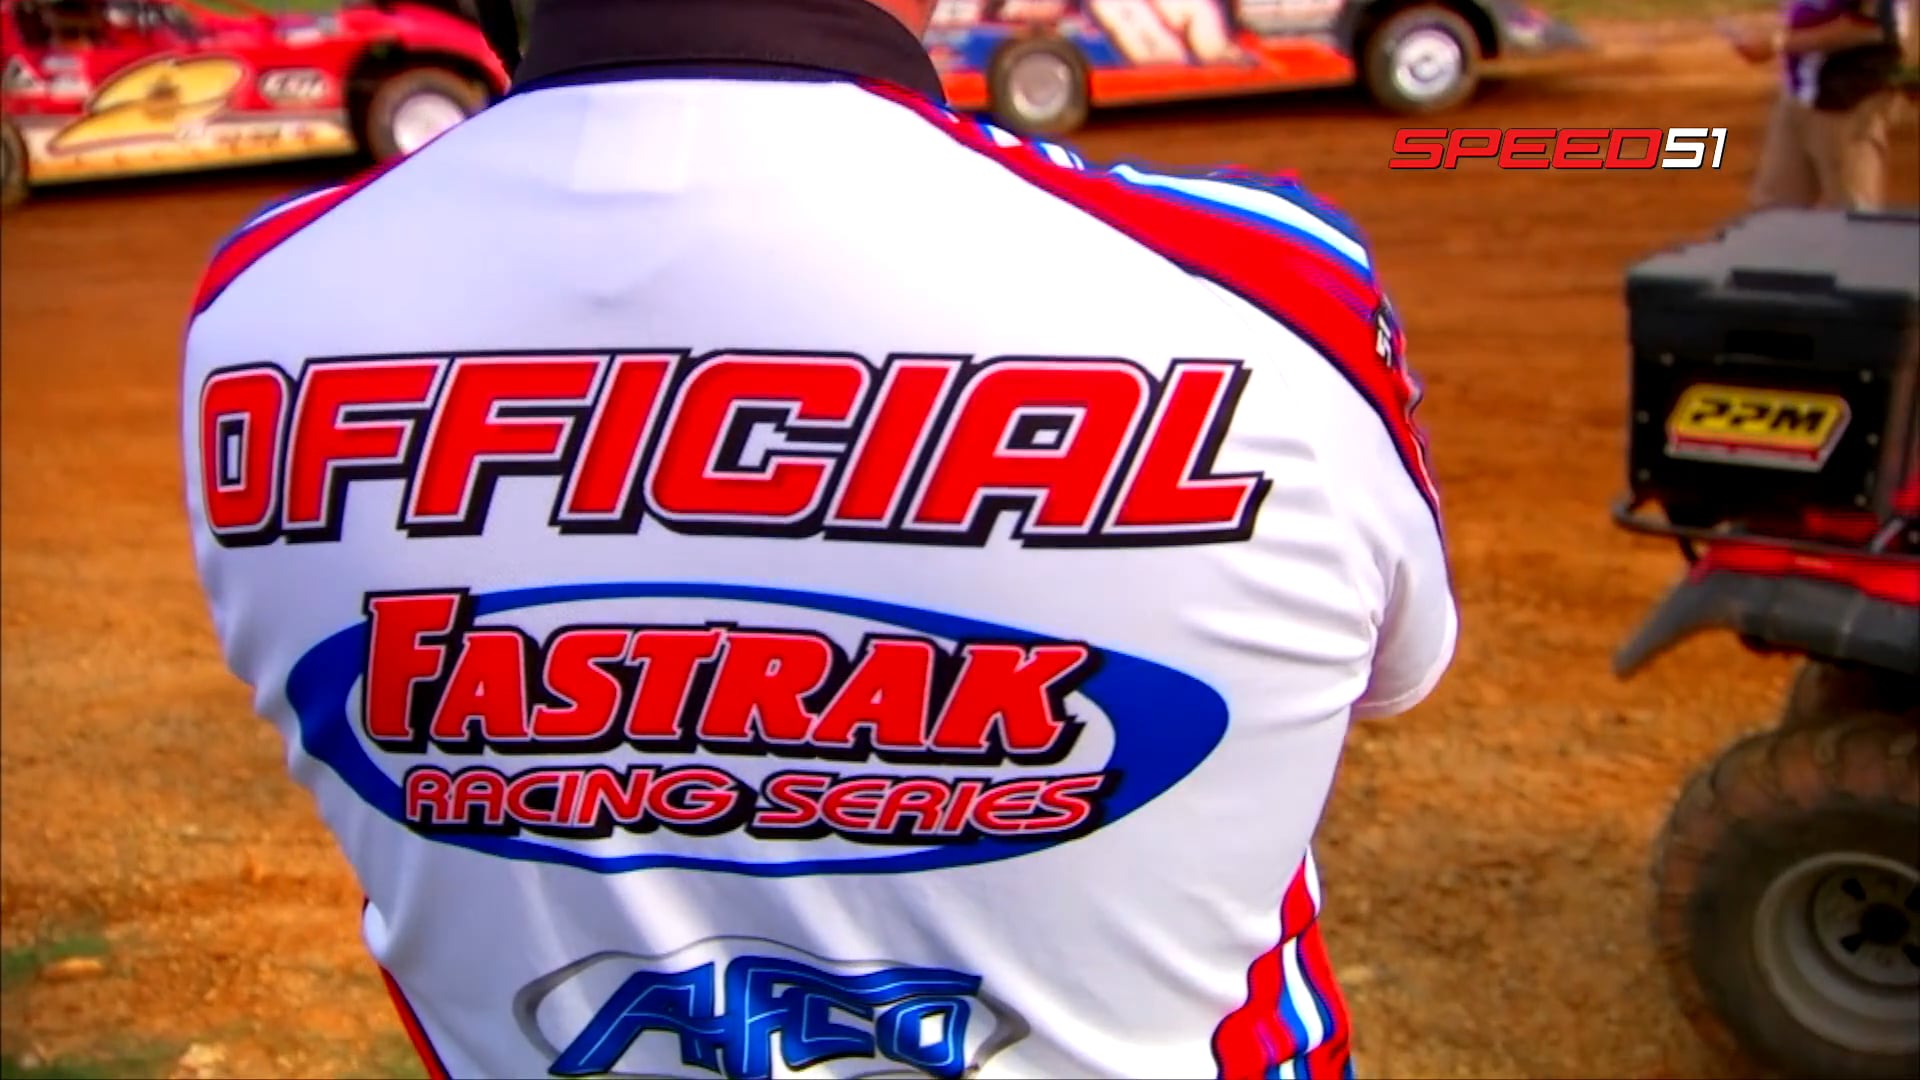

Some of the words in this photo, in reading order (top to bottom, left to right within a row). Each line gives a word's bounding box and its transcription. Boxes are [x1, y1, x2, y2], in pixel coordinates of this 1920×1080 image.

[200, 349, 1270, 548] OFFICIAL
[364, 589, 1100, 763] FASTRAK
[404, 767, 742, 838] RACING
[752, 770, 1112, 842] SERIES
[548, 956, 982, 1079] AFCO
